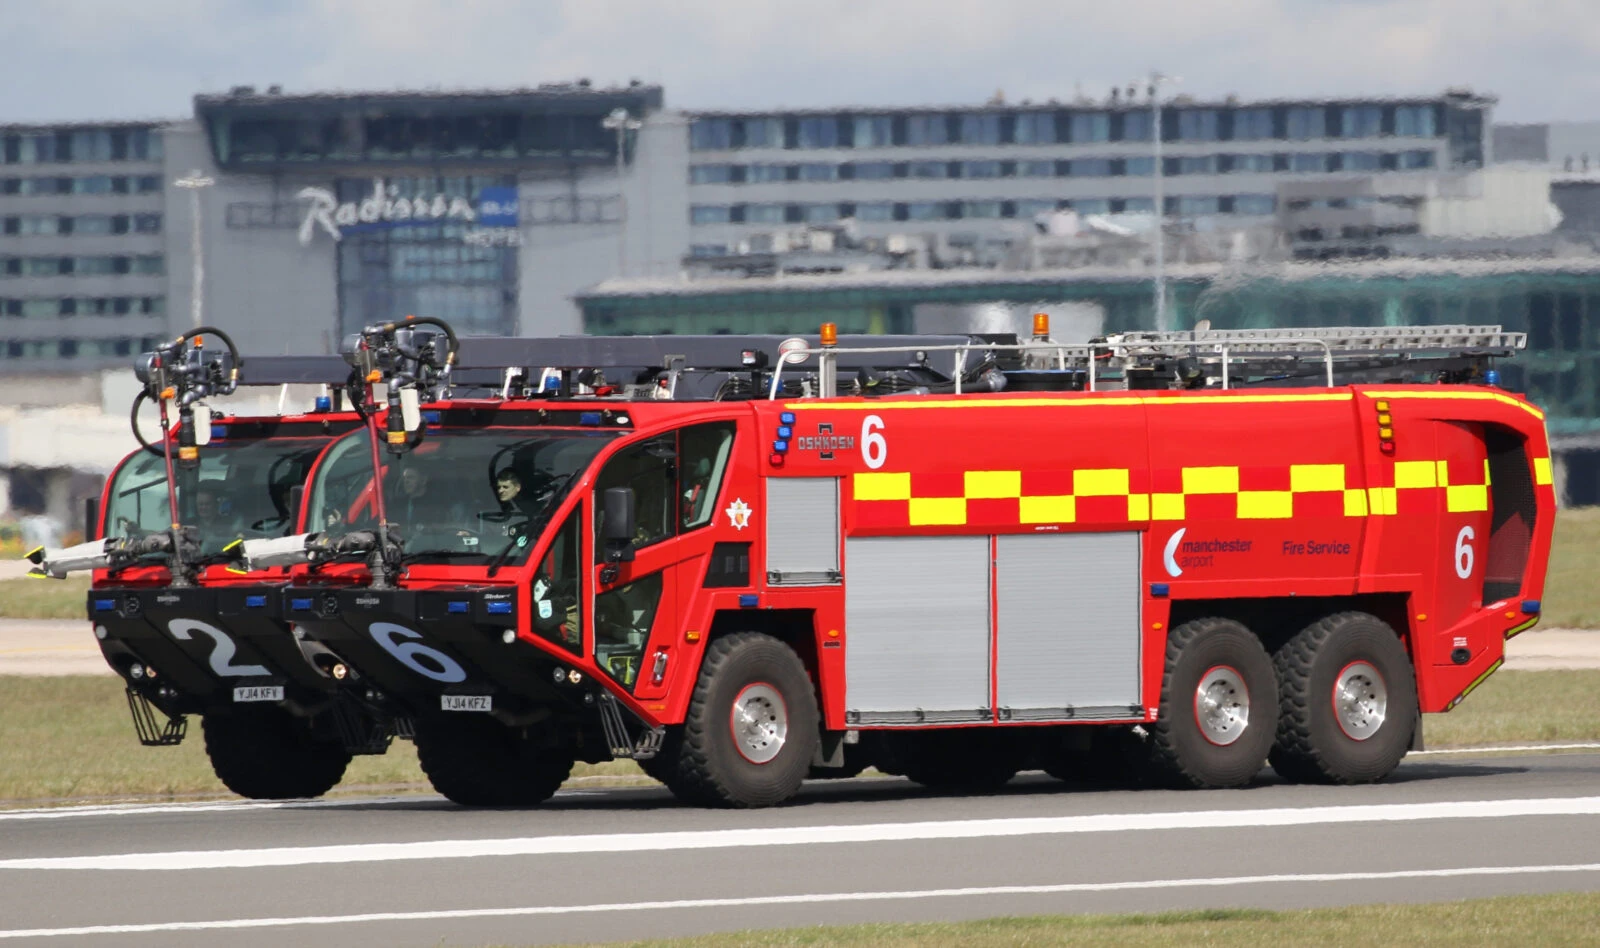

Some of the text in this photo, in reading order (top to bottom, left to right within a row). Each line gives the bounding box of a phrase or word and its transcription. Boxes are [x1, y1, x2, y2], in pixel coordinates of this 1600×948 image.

[798, 436, 854, 450] OSHKOSH
[861, 414, 887, 469] 6
[1182, 539, 1252, 553] manchester
[1282, 540, 1351, 555] Fire Service
[1455, 525, 1475, 579] 6
[1181, 554, 1214, 568] airport
[168, 618, 272, 677] 2
[368, 622, 467, 683] 6
[238, 687, 259, 699] YJ14
[445, 697, 487, 710] YJ14 KFZ
